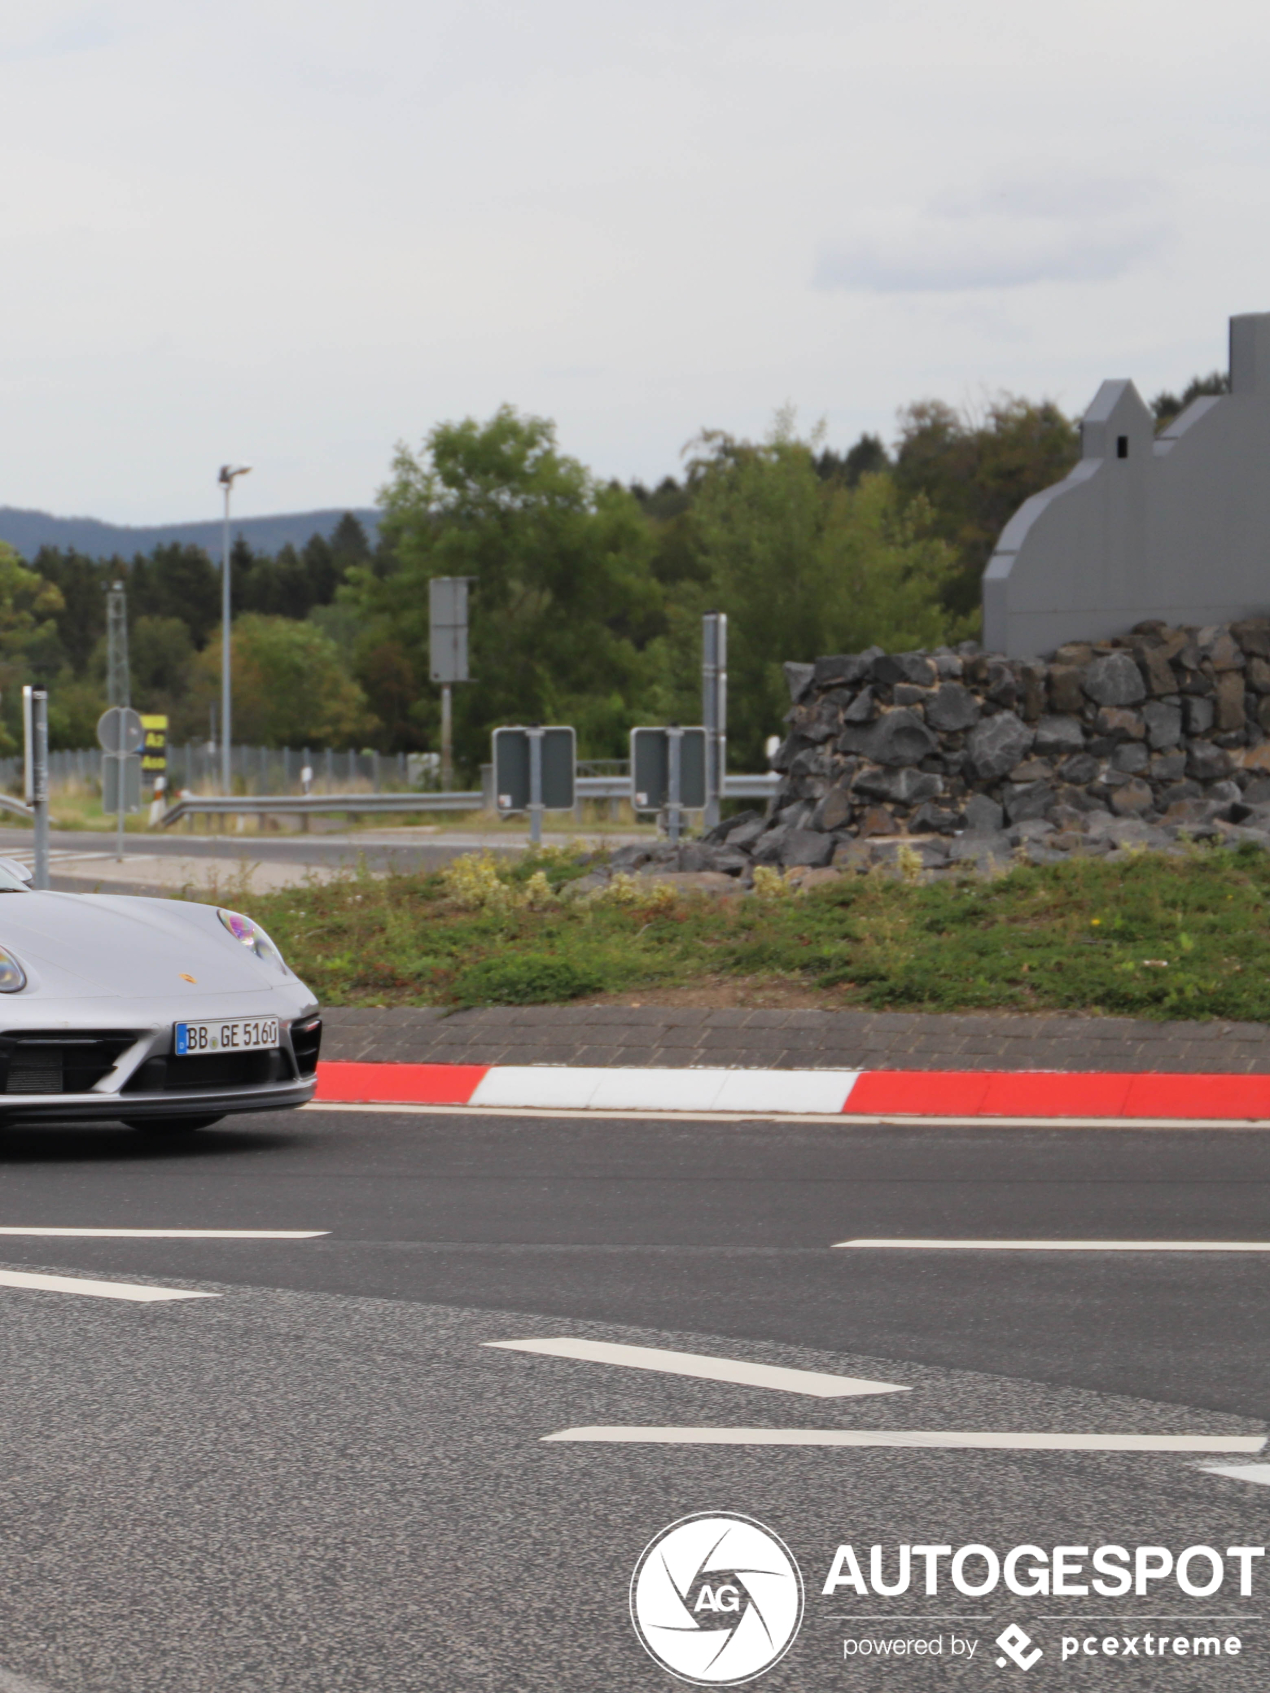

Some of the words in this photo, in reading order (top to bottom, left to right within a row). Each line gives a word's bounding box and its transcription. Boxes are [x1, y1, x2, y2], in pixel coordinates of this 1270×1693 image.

[187, 1026, 208, 1050] BB
[221, 1024, 240, 1048] GE
[243, 1020, 277, 1046] 5160
